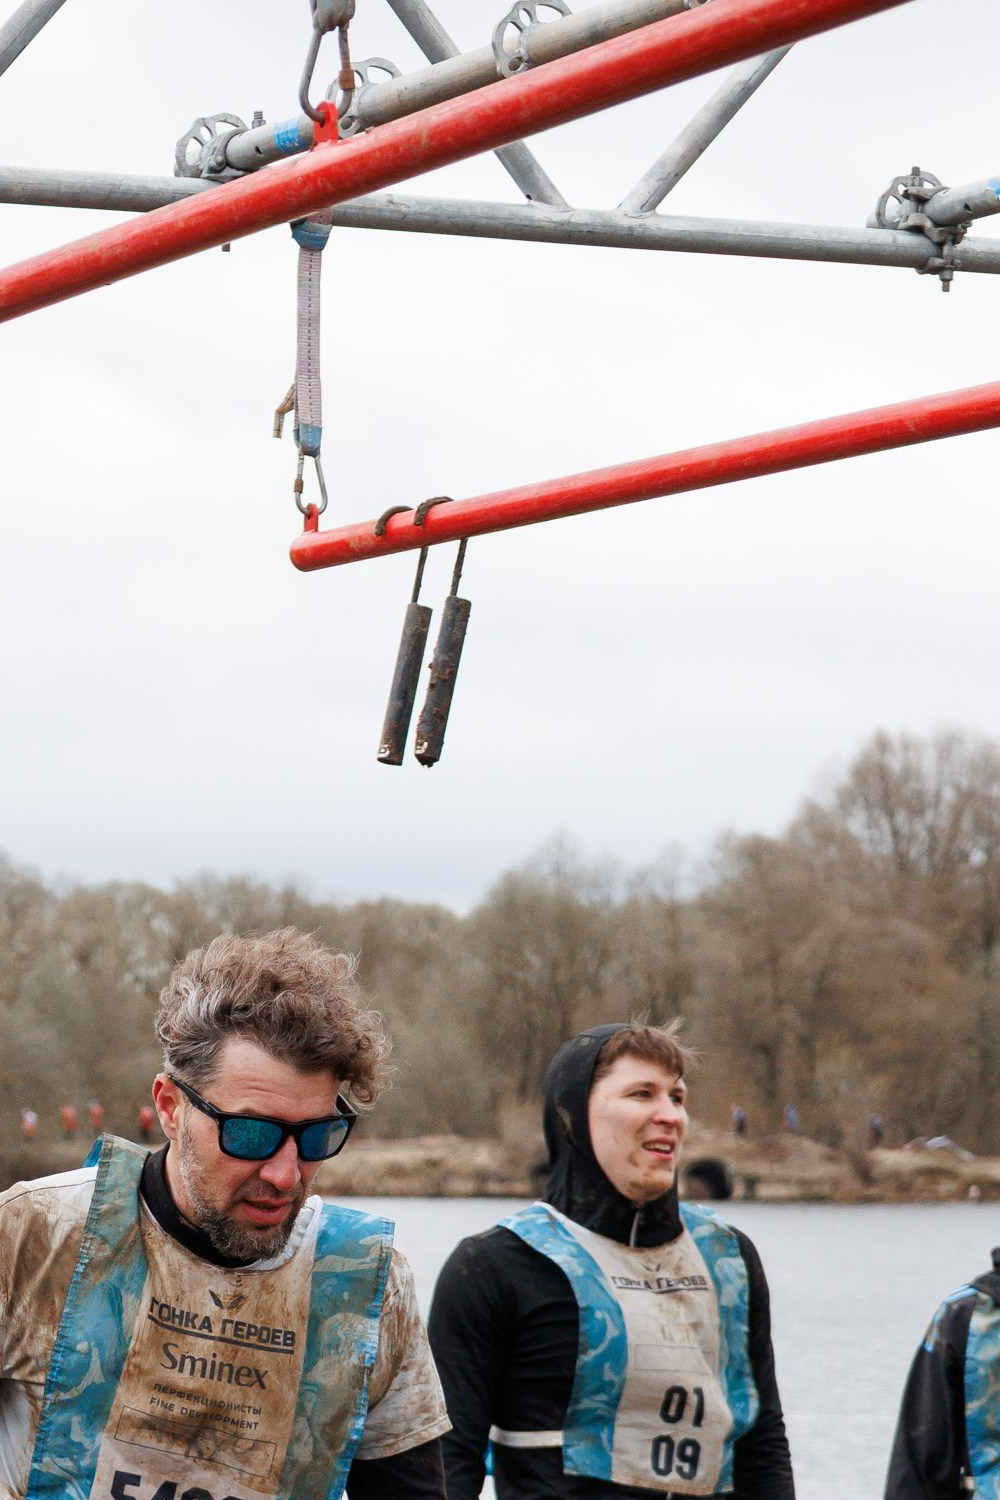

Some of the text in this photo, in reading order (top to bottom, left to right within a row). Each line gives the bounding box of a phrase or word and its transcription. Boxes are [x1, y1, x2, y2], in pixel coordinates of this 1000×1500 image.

[149, 1297, 296, 1347] ГОНКА ГЕРОЕВ
[160, 1341, 269, 1390] Sminex
[150, 1397, 259, 1430] FINE DEVELOPMENT
[153, 1383, 262, 1416] ПЕРФЕКЦИОНИСТЫ
[659, 1384, 705, 1428] 01
[651, 1435, 700, 1481] 09
